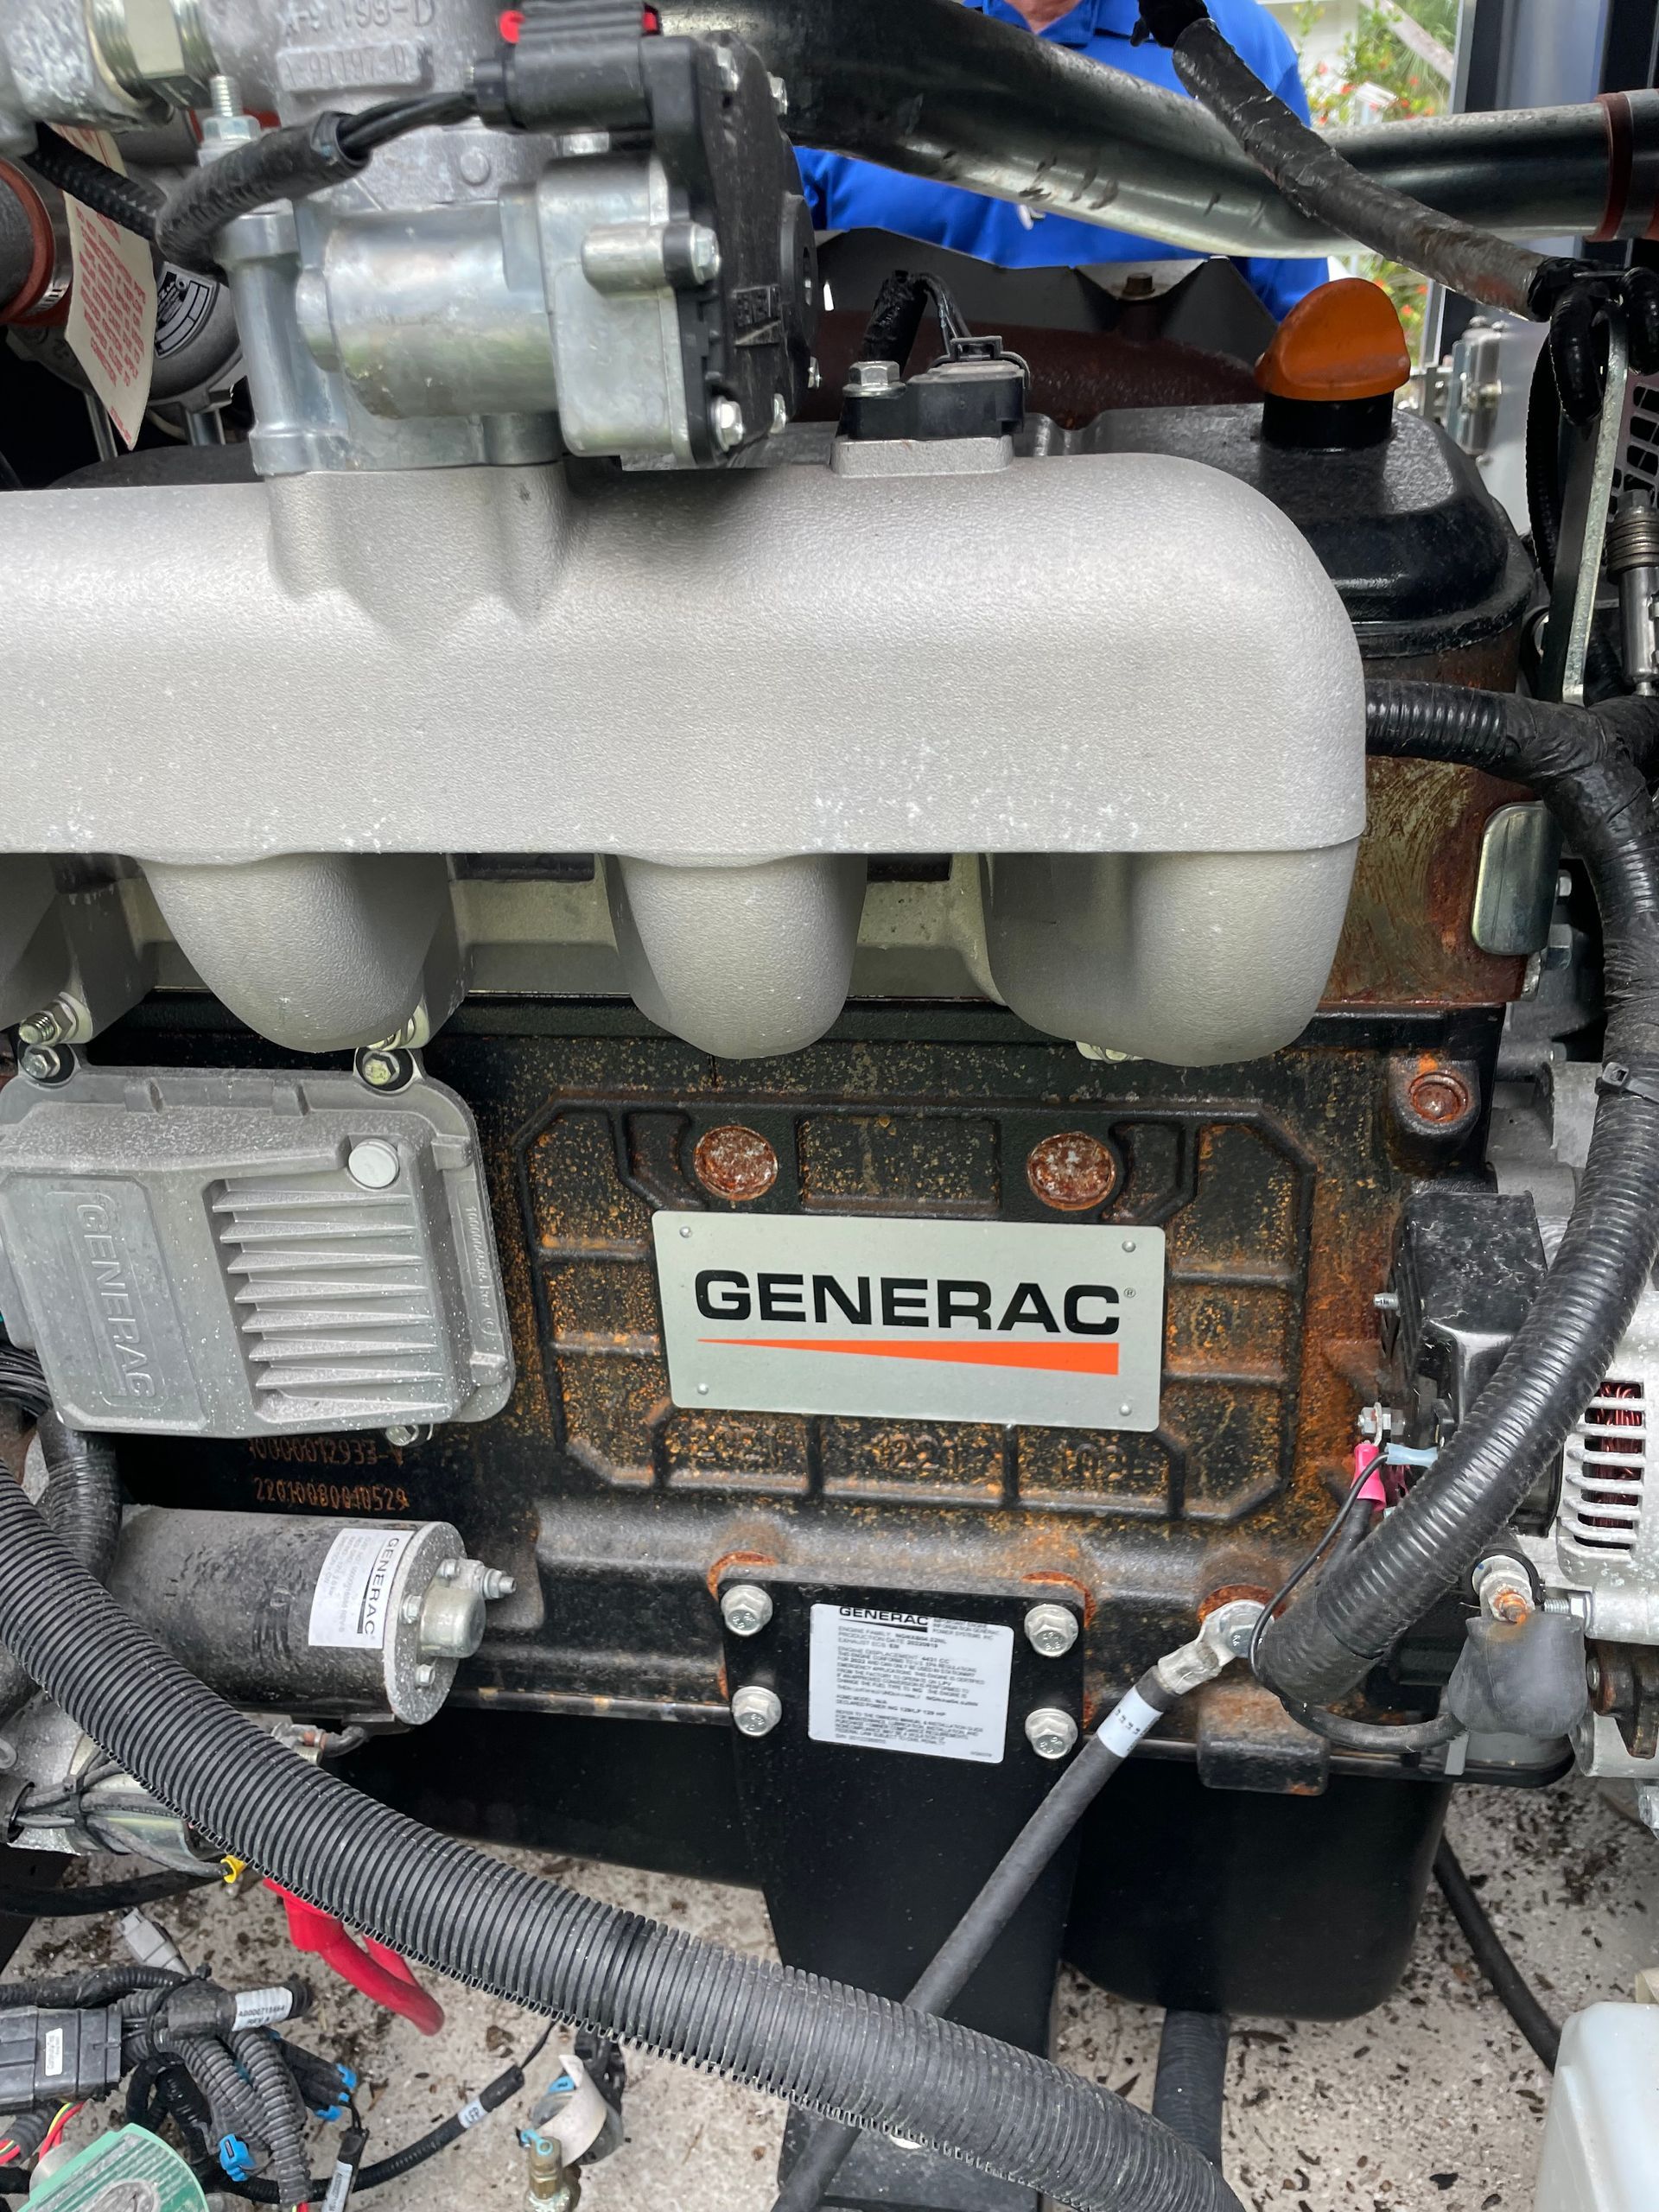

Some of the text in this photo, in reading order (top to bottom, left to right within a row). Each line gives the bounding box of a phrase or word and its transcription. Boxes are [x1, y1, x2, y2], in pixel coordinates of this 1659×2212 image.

[77, 1205, 156, 1397] GENERAC
[695, 1269, 1119, 1335] GENERAC
[365, 1538, 399, 1636] GENERAC
[839, 1606, 929, 1625] GENERAC
